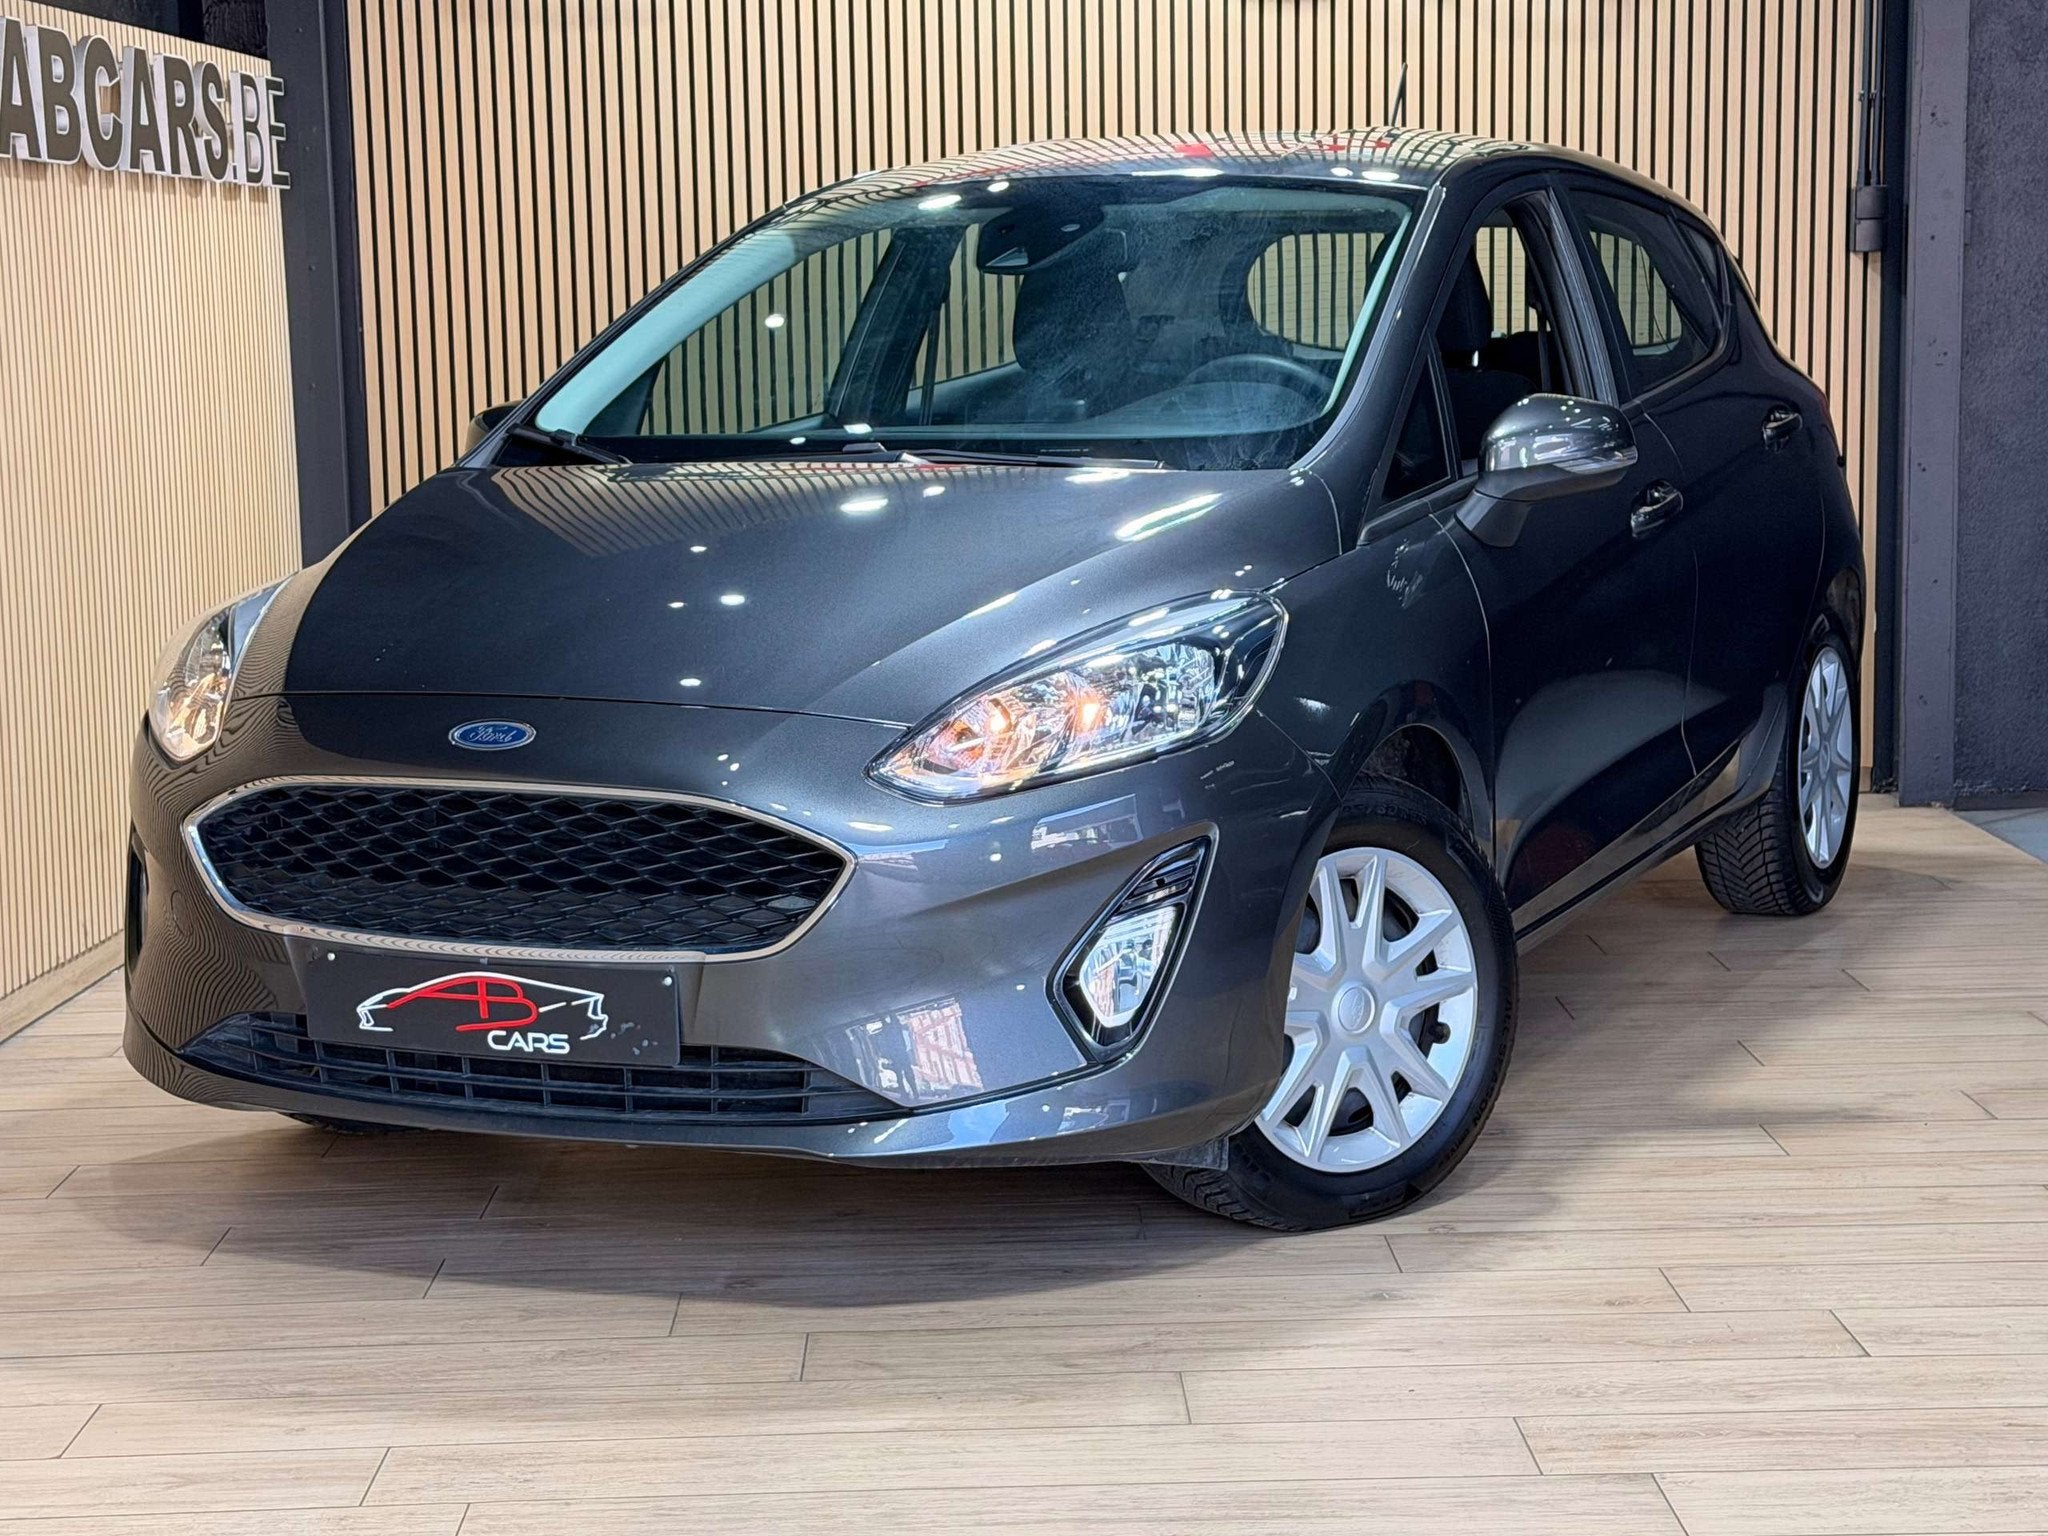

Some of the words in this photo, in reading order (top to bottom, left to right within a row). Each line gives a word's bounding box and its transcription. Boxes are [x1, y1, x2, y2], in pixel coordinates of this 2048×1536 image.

[0, 16, 291, 189] ABCARS.BE
[469, 724, 518, 743] Ford
[487, 1030, 570, 1055] CARS
